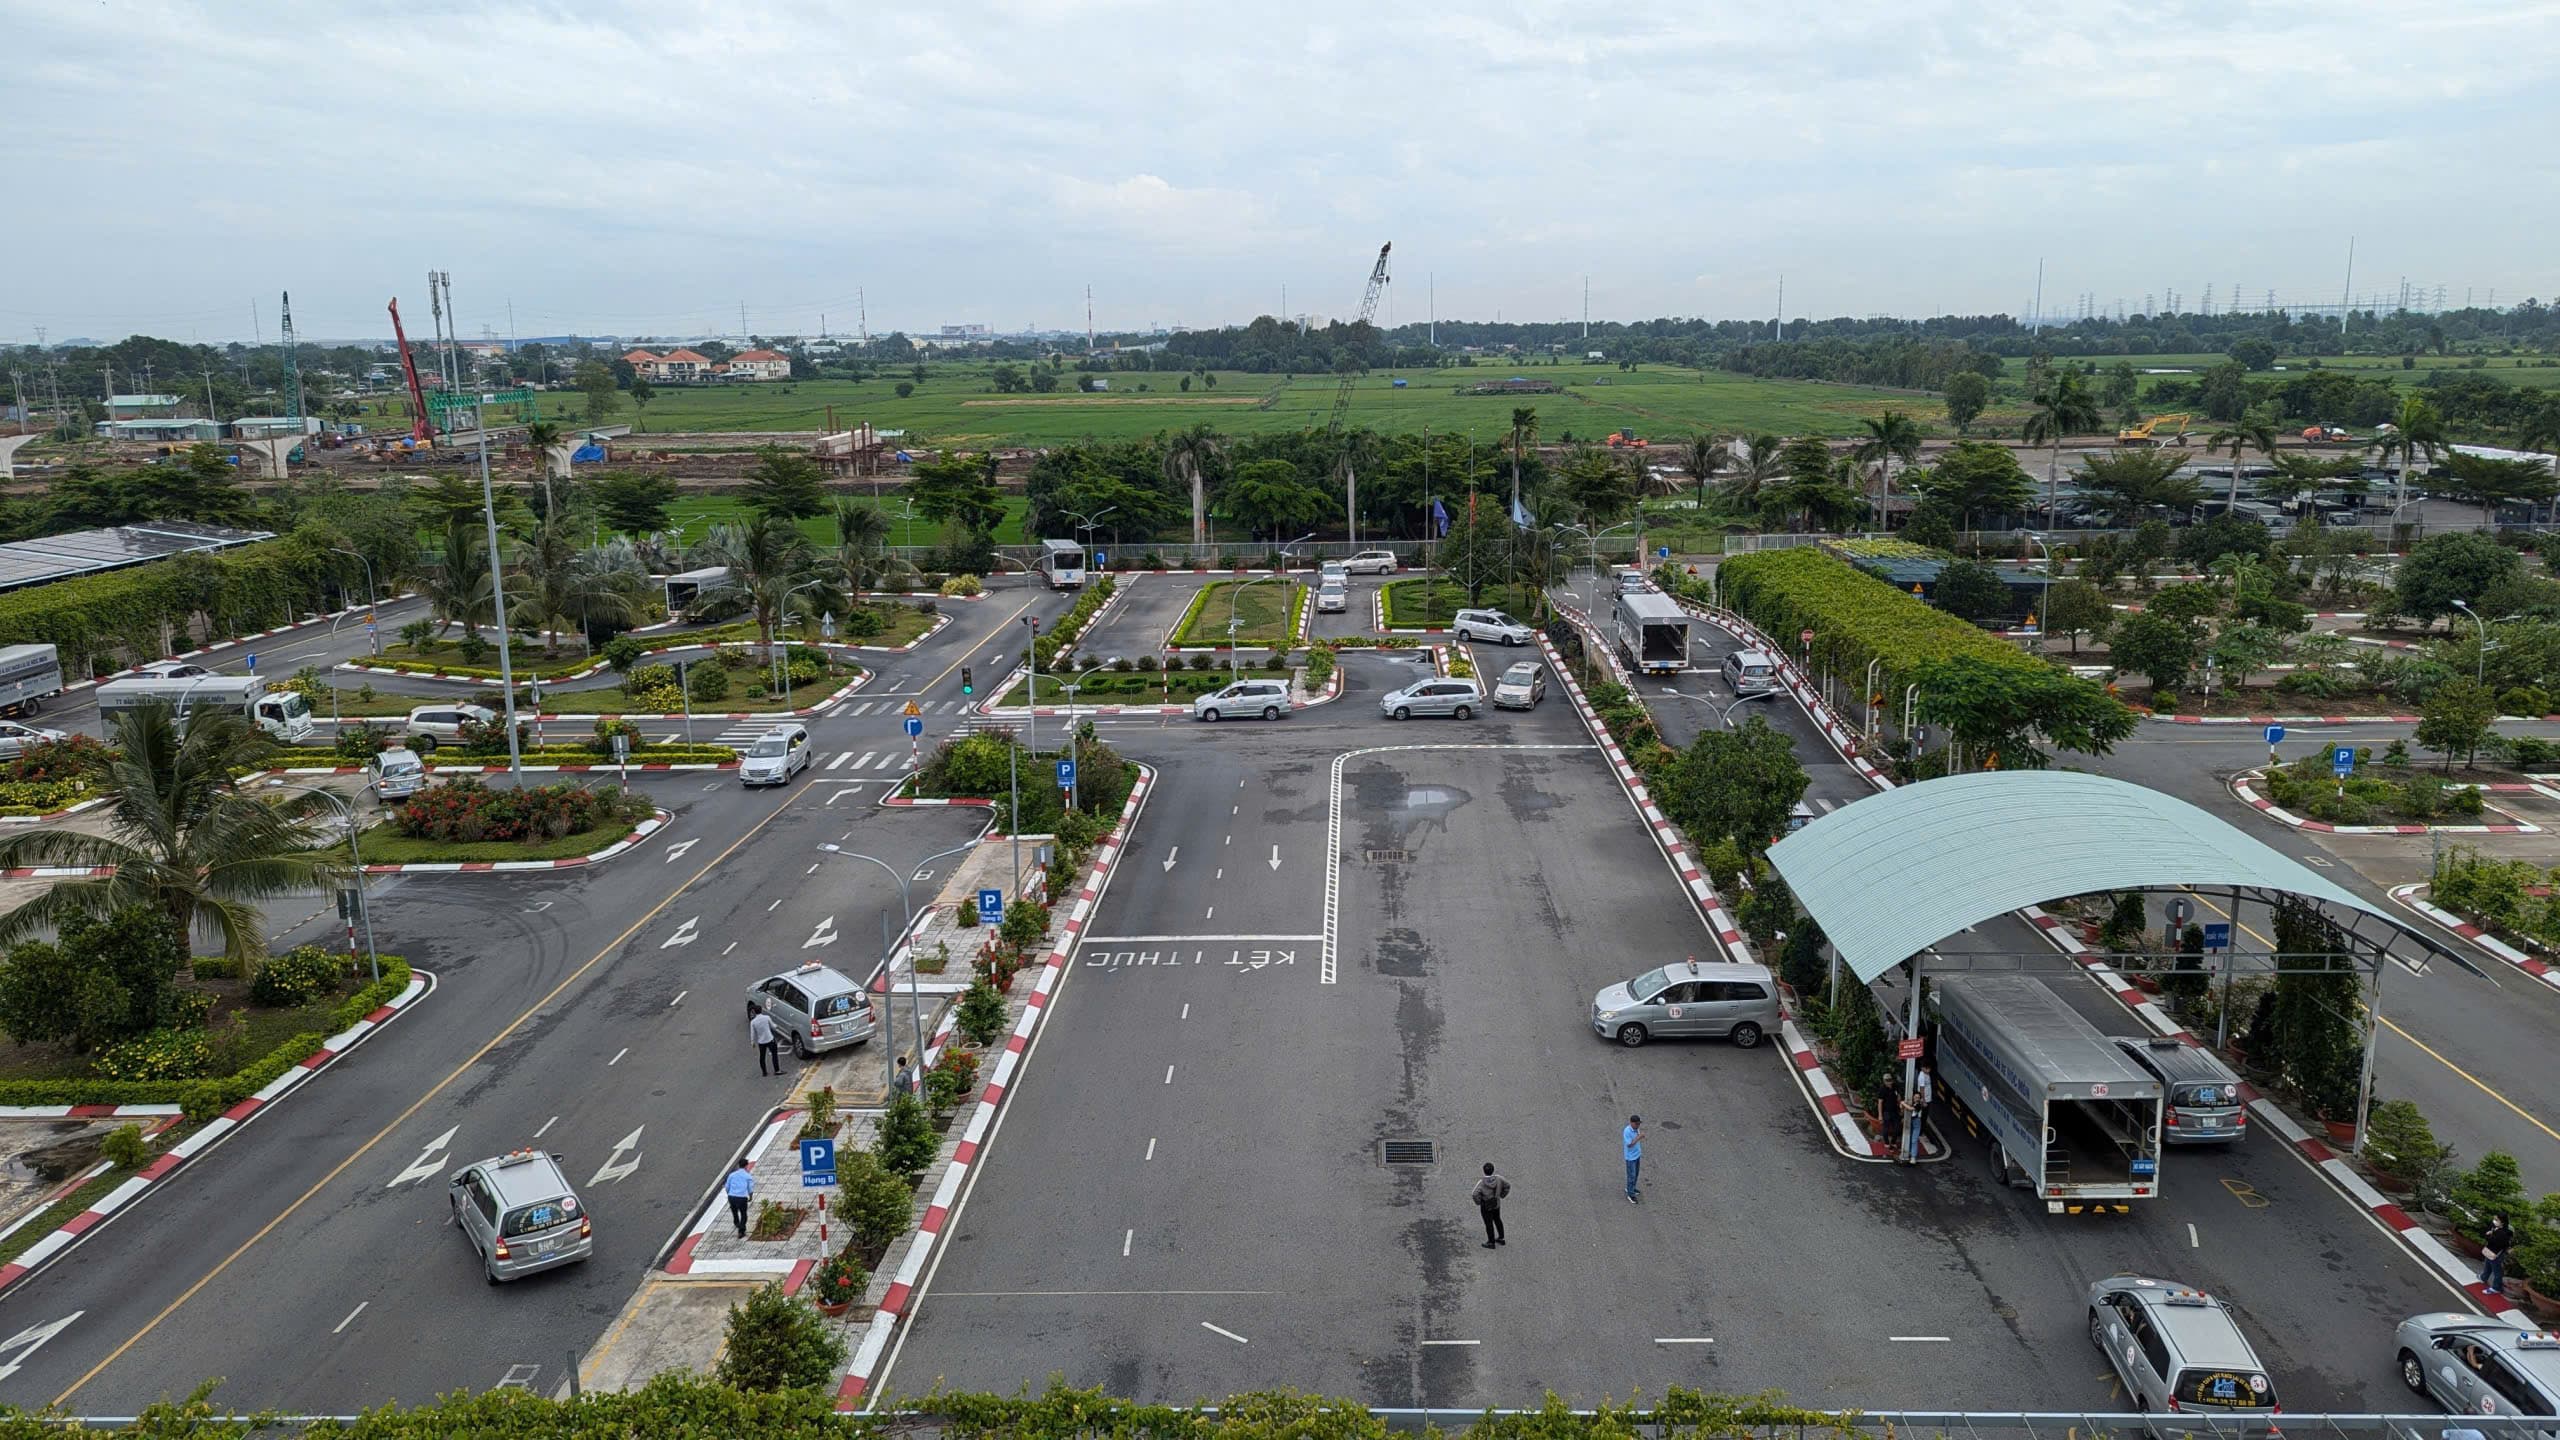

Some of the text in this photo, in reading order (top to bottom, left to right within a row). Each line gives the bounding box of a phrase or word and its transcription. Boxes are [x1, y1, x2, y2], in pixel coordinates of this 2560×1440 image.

[2340, 751, 2349, 762] P
[1062, 764, 1071, 776] P
[985, 894, 997, 909] P
[1086, 950, 1296, 972] KẾT THÚC
[1671, 1007, 1681, 1016] 19
[2093, 1085, 2107, 1095] 36
[810, 1146, 825, 1165] P
[804, 1175, 834, 1185] Hạng B
[2219, 1179, 2271, 1208] B
